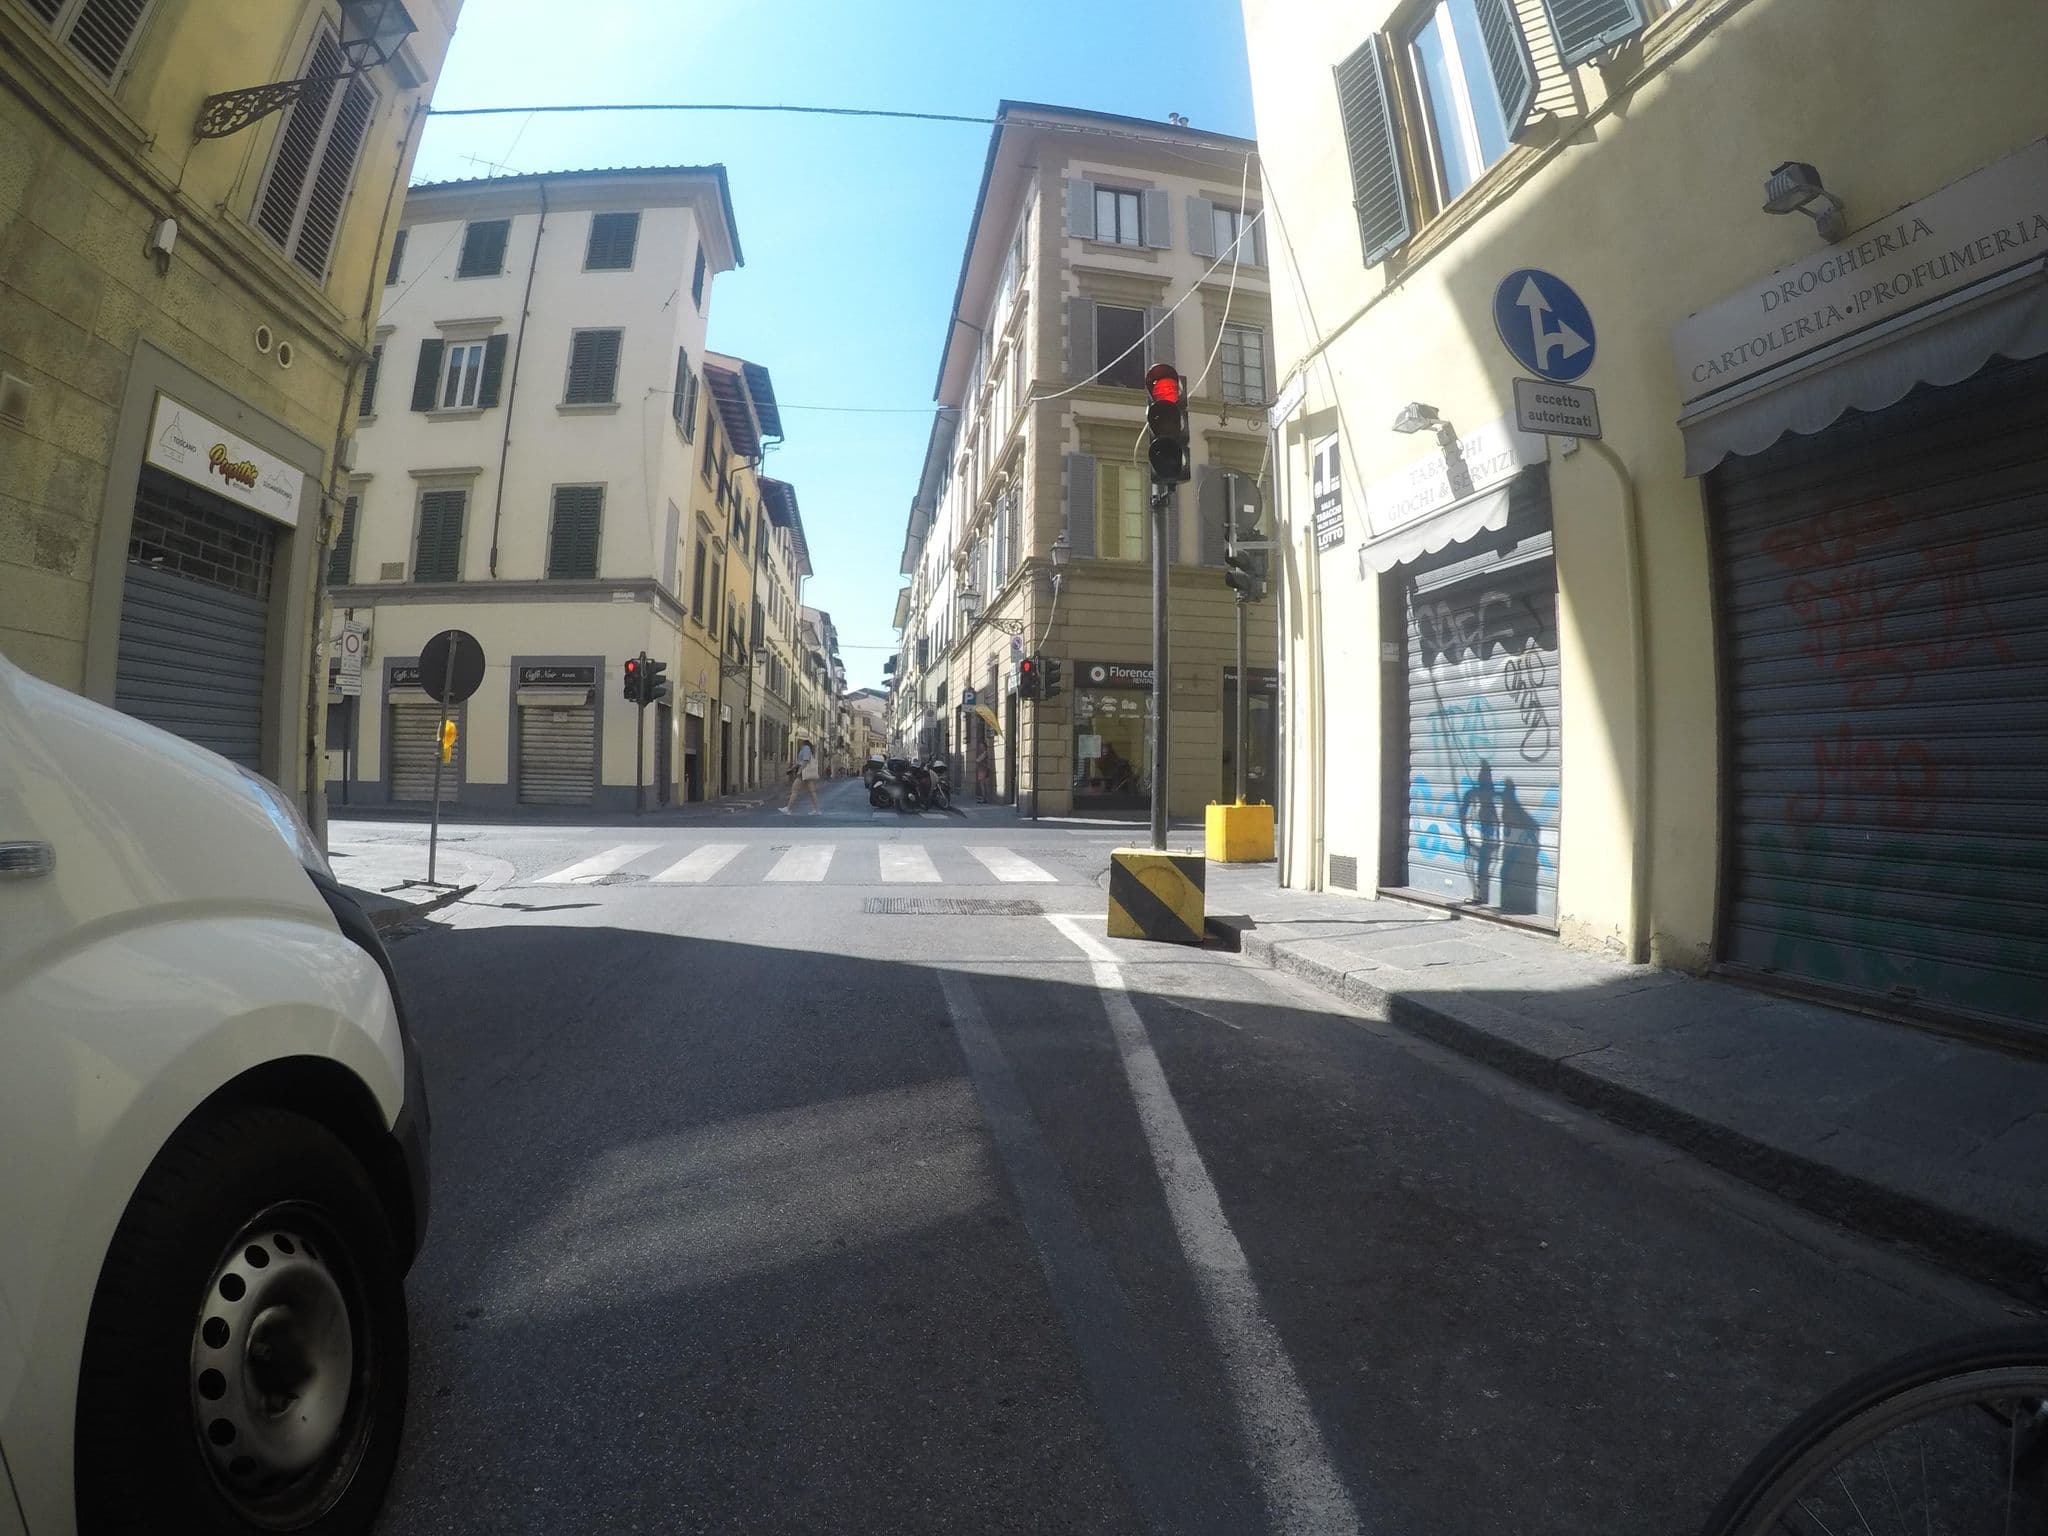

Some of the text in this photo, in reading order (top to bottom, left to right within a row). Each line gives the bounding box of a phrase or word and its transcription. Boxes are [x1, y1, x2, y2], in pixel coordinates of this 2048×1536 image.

[1760, 216, 1935, 313] DROGHERIA
[1535, 394, 1581, 409] eccetto
[1528, 410, 1592, 427] autorizzati
[173, 436, 197, 453] TOSCANO
[1409, 436, 1484, 486] TABAHI
[1388, 488, 1435, 521] GIOCHI
[1454, 448, 1516, 490] SERVIZI
[1316, 504, 1342, 522] TABACCHI
[1318, 527, 1343, 547] LOTTO
[1109, 666, 1154, 678] Florence
